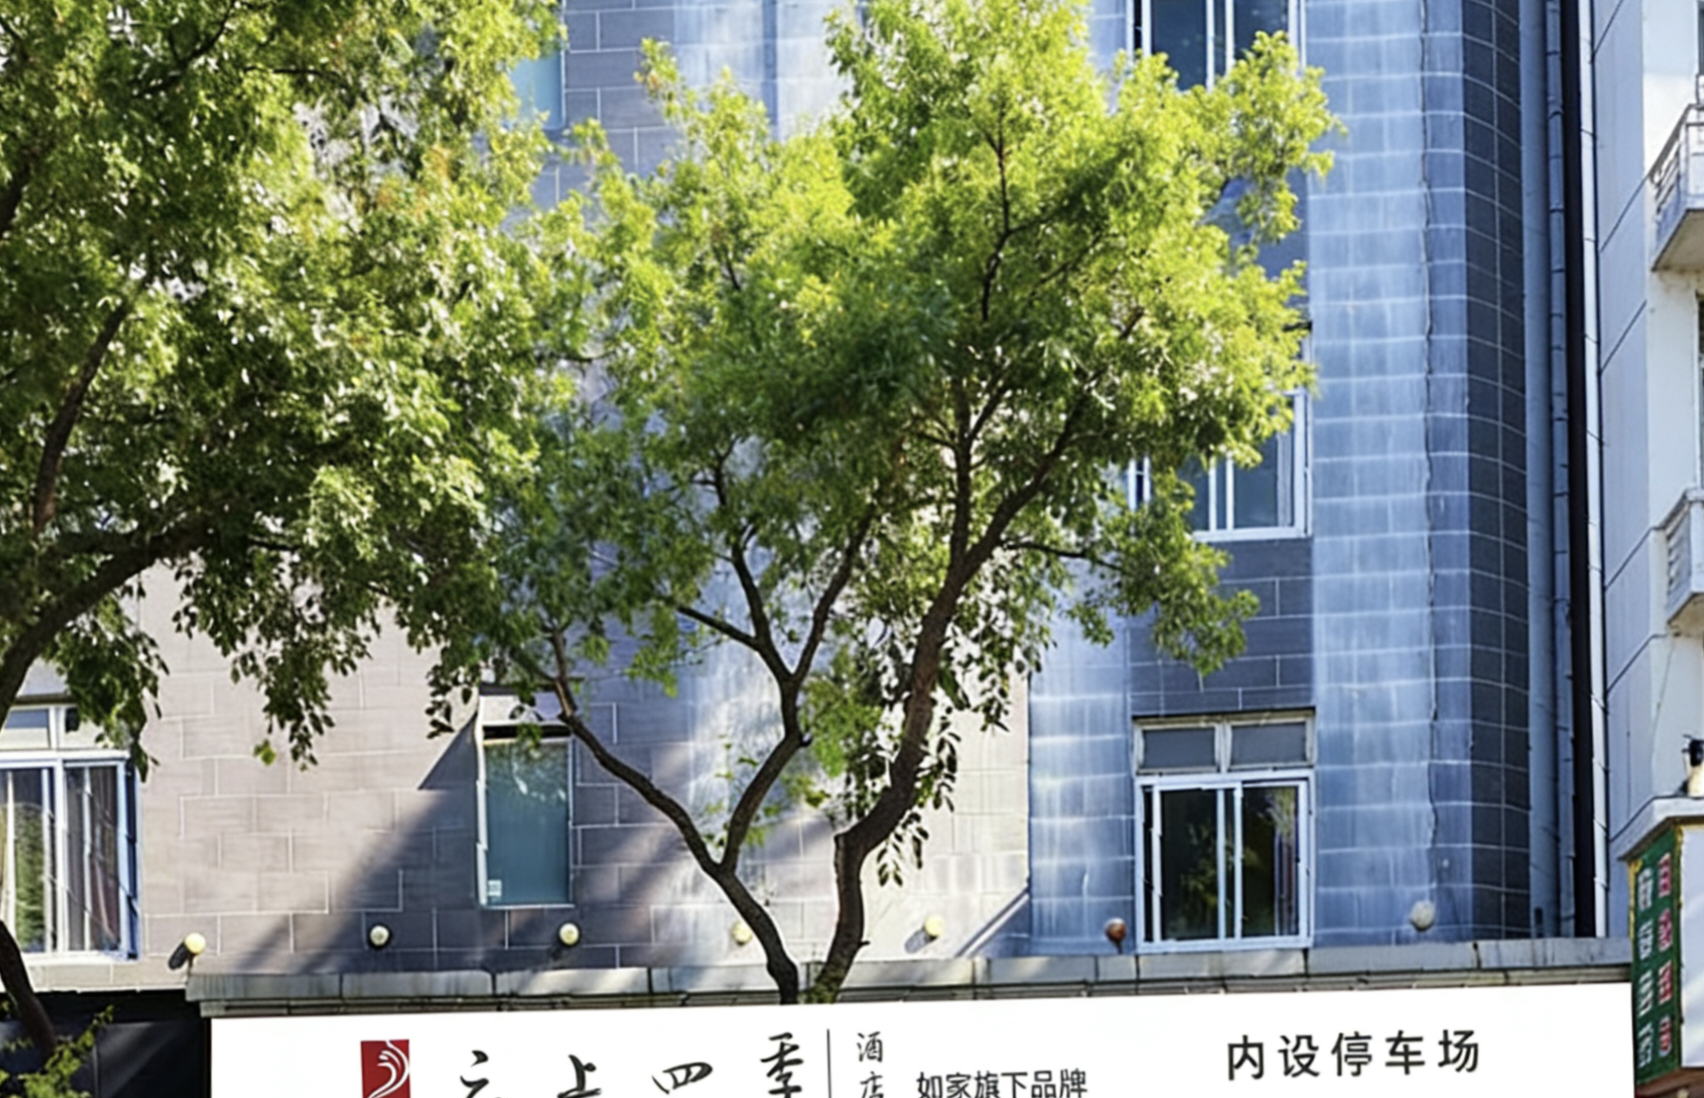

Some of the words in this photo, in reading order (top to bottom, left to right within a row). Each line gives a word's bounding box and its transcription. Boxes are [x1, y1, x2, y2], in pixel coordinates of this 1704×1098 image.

[1227, 1029, 1479, 1081] 内设停车场
